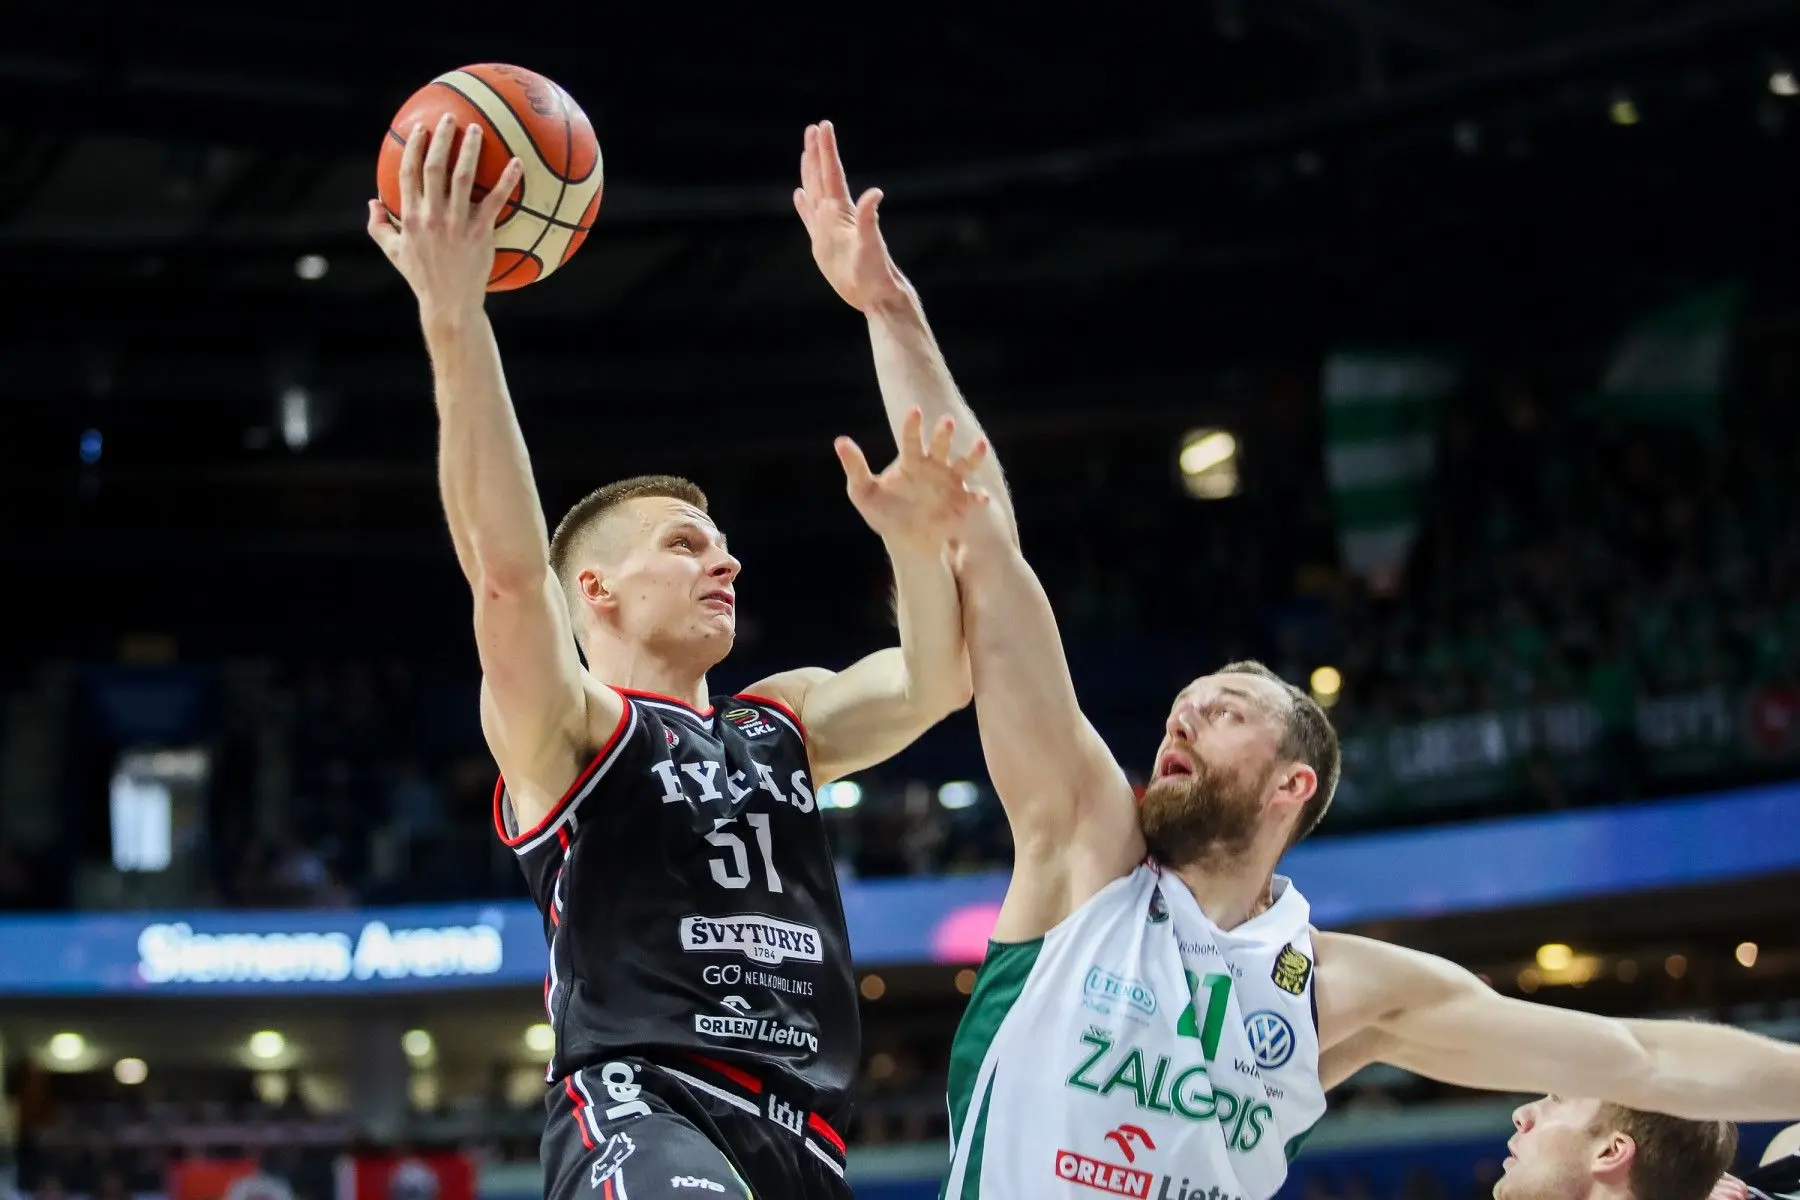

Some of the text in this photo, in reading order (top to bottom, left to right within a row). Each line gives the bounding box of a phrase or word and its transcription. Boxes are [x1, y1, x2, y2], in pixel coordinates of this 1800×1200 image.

[746, 723, 776, 738] LKL
[704, 812, 784, 894] 51
[691, 918, 816, 955] ŠVYTURYS
[754, 946, 777, 960] 1784
[702, 964, 814, 997] GO NEALKOHOLINIS
[699, 1017, 755, 1037] ORLEN
[1059, 1154, 1147, 1195] ORLEN
